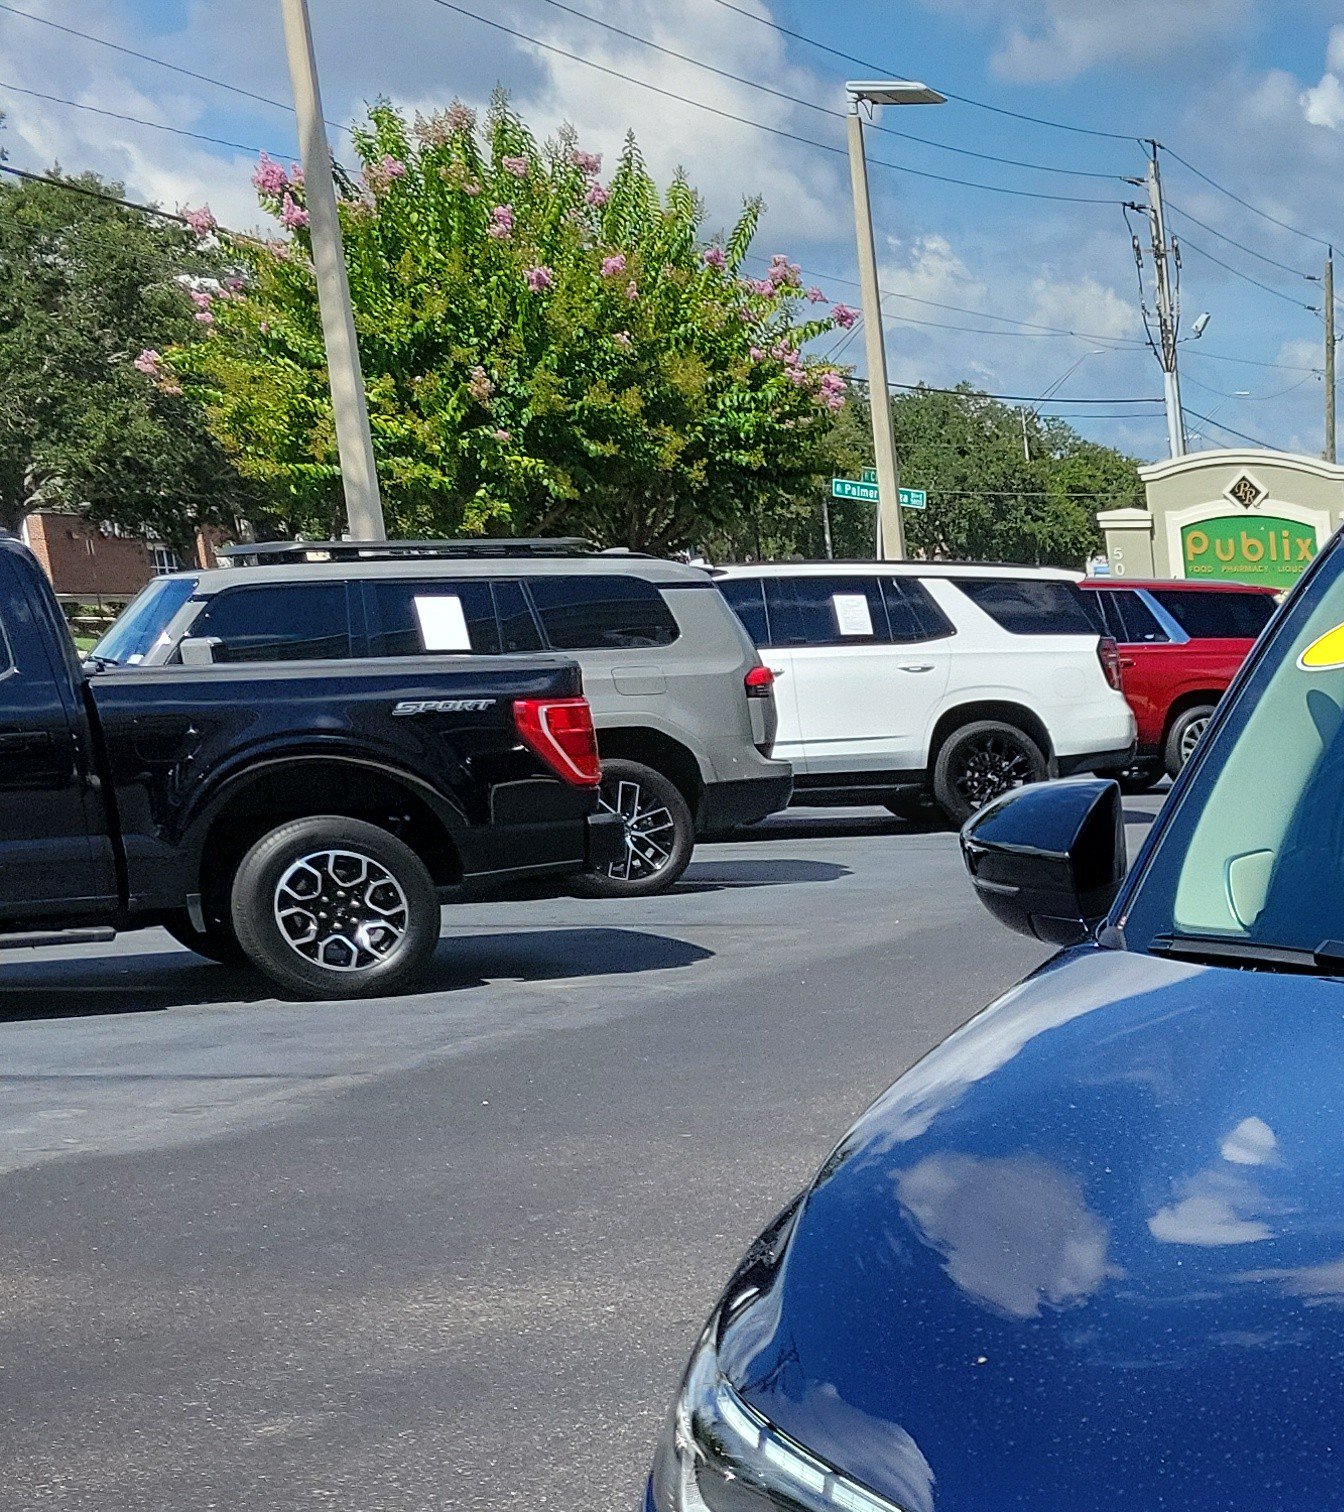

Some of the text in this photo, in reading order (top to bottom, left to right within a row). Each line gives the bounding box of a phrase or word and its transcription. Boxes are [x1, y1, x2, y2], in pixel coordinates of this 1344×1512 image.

[844, 483, 878, 499] Palmer
[1186, 530, 1312, 562] Publix
[391, 699, 496, 716] SPORT
